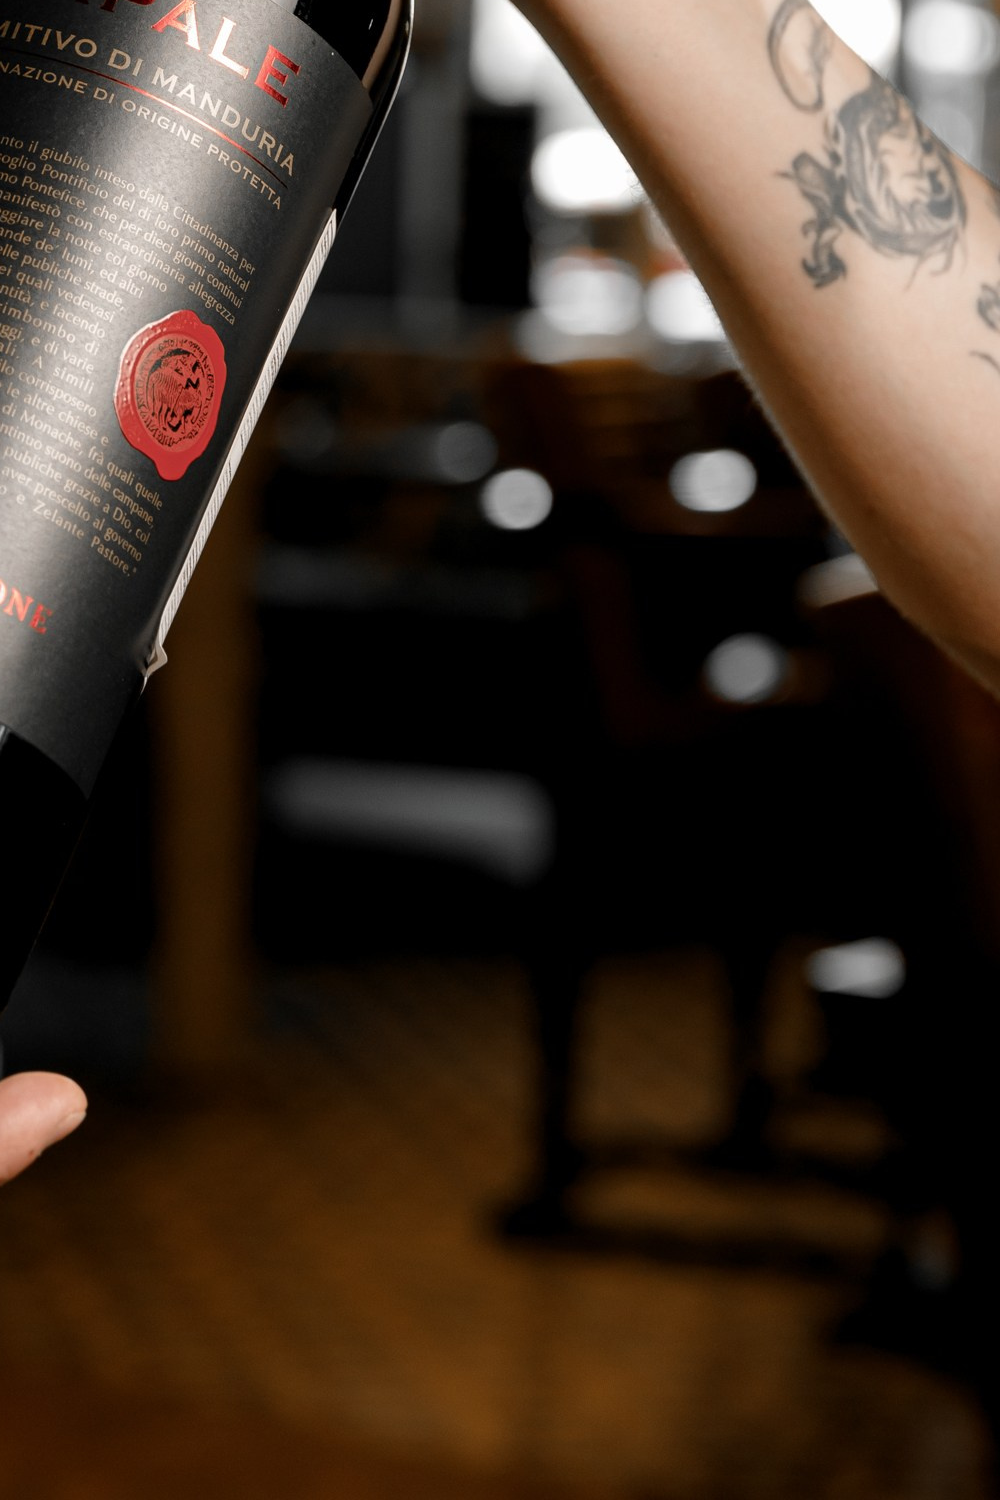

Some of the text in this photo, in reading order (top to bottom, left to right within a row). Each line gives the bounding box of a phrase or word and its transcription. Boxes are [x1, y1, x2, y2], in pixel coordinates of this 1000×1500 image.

[107, 48, 144, 77] DI
[151, 67, 296, 177] MANDURIA
[93, 87, 116, 104] DI
[121, 100, 204, 148] ORIGINE
[207, 143, 281, 210] PROTETTA
[22, 176, 88, 212] Pontefice,
[93, 205, 117, 224] che
[118, 219, 142, 236] per
[144, 230, 174, 254] dieci
[173, 251, 207, 277] giorni
[207, 274, 244, 309] continui
[28, 140, 39, 153] il
[40, 148, 90, 171] giubilo
[95, 164, 136, 192] inteso
[138, 187, 169, 215] dalla
[173, 202, 239, 261] Cittadinanza
[239, 258, 256, 275] per
[41, 164, 108, 199] Pontificio
[113, 194, 136, 212] del
[138, 207, 152, 221] di
[155, 214, 179, 238] loro
[180, 235, 215, 263] primo
[218, 260, 250, 292] natural
[21, 255, 82, 286] publiche
[84, 281, 127, 312] strade,
[48, 222, 61, 238] la
[66, 232, 102, 255] notte
[106, 251, 127, 268] col
[126, 264, 168, 293] giorno
[62, 247, 94, 275] lumi,
[100, 269, 118, 283] ed
[119, 279, 144, 299] altri
[66, 214, 93, 232] con
[99, 228, 185, 284] estraordinaria
[188, 282, 235, 326] allegrezza
[16, 272, 54, 292] quali
[58, 288, 115, 323] vedevasi
[40, 301, 49, 310] e
[52, 303, 105, 341] facendo
[31, 337, 41, 347] e
[44, 341, 60, 356] di
[63, 350, 94, 375] varie
[32, 356, 42, 369] A
[53, 366, 95, 397] simili
[85, 340, 100, 356] di
[7, 382, 20, 399] le
[24, 393, 55, 415] altre
[58, 411, 98, 440] chiese
[101, 436, 109, 447] e
[18, 372, 97, 417] corrisposero
[2, 402, 17, 417] di
[20, 410, 83, 456] Monache,
[107, 462, 135, 486] quali
[135, 482, 163, 511] quelle
[45, 446, 82, 472] suono
[84, 468, 111, 492] delle
[113, 488, 154, 529] campane,
[2, 446, 62, 482] publiche
[64, 479, 101, 507] grazie
[103, 504, 110, 514] a
[113, 507, 132, 533] Dio,
[136, 528, 151, 545] col
[2, 466, 33, 490] aver
[33, 482, 90, 521] prescelto
[93, 518, 105, 531] al
[104, 528, 142, 562] governo
[16, 494, 26, 505] e
[33, 500, 85, 539] Zelante
